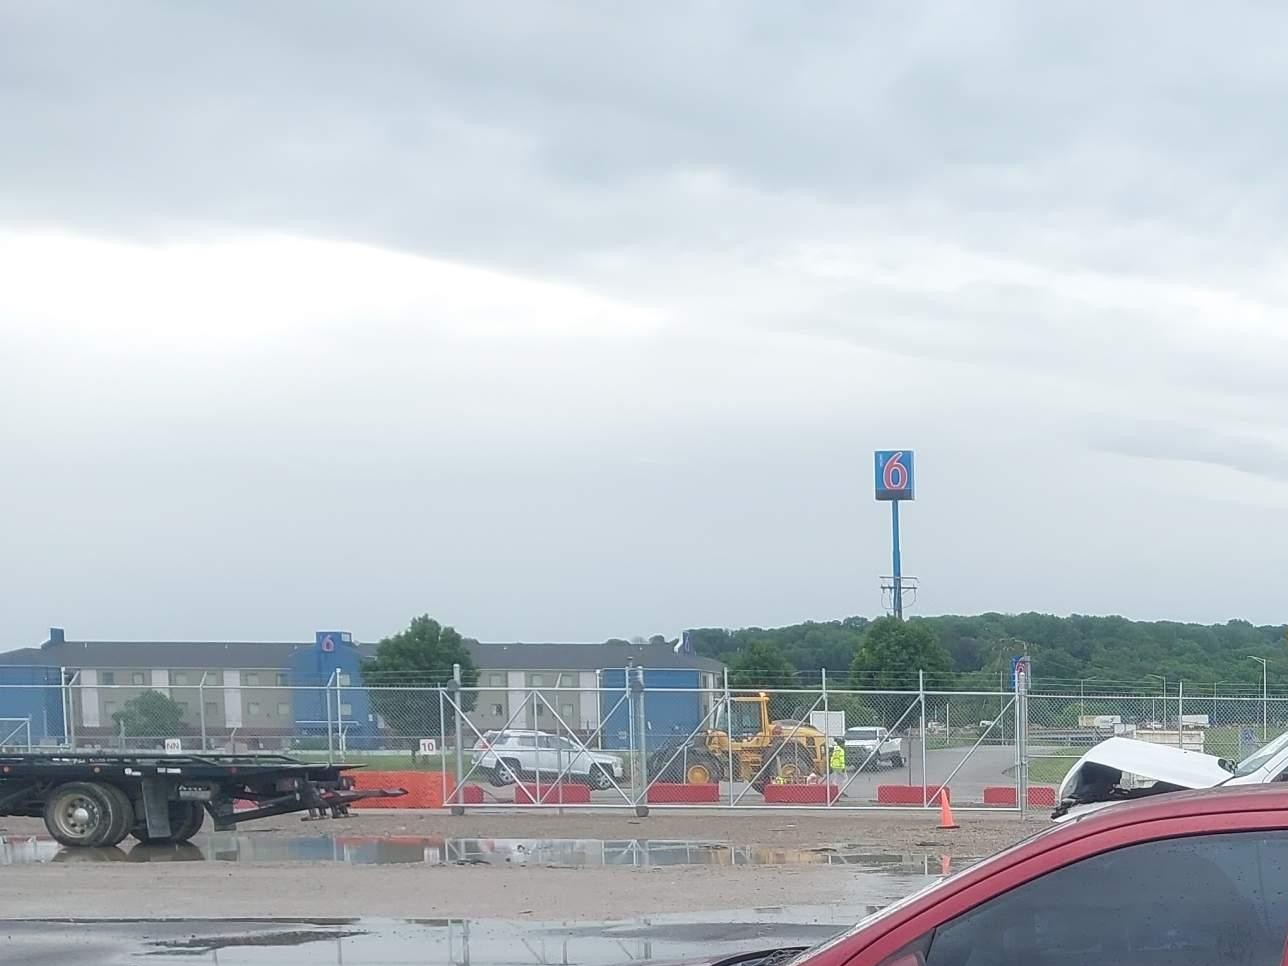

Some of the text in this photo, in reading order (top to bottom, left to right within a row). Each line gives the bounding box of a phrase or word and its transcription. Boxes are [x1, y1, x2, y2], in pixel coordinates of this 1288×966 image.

[883, 451, 908, 490] 6
[321, 634, 335, 651] 6
[421, 742, 434, 751] 10
